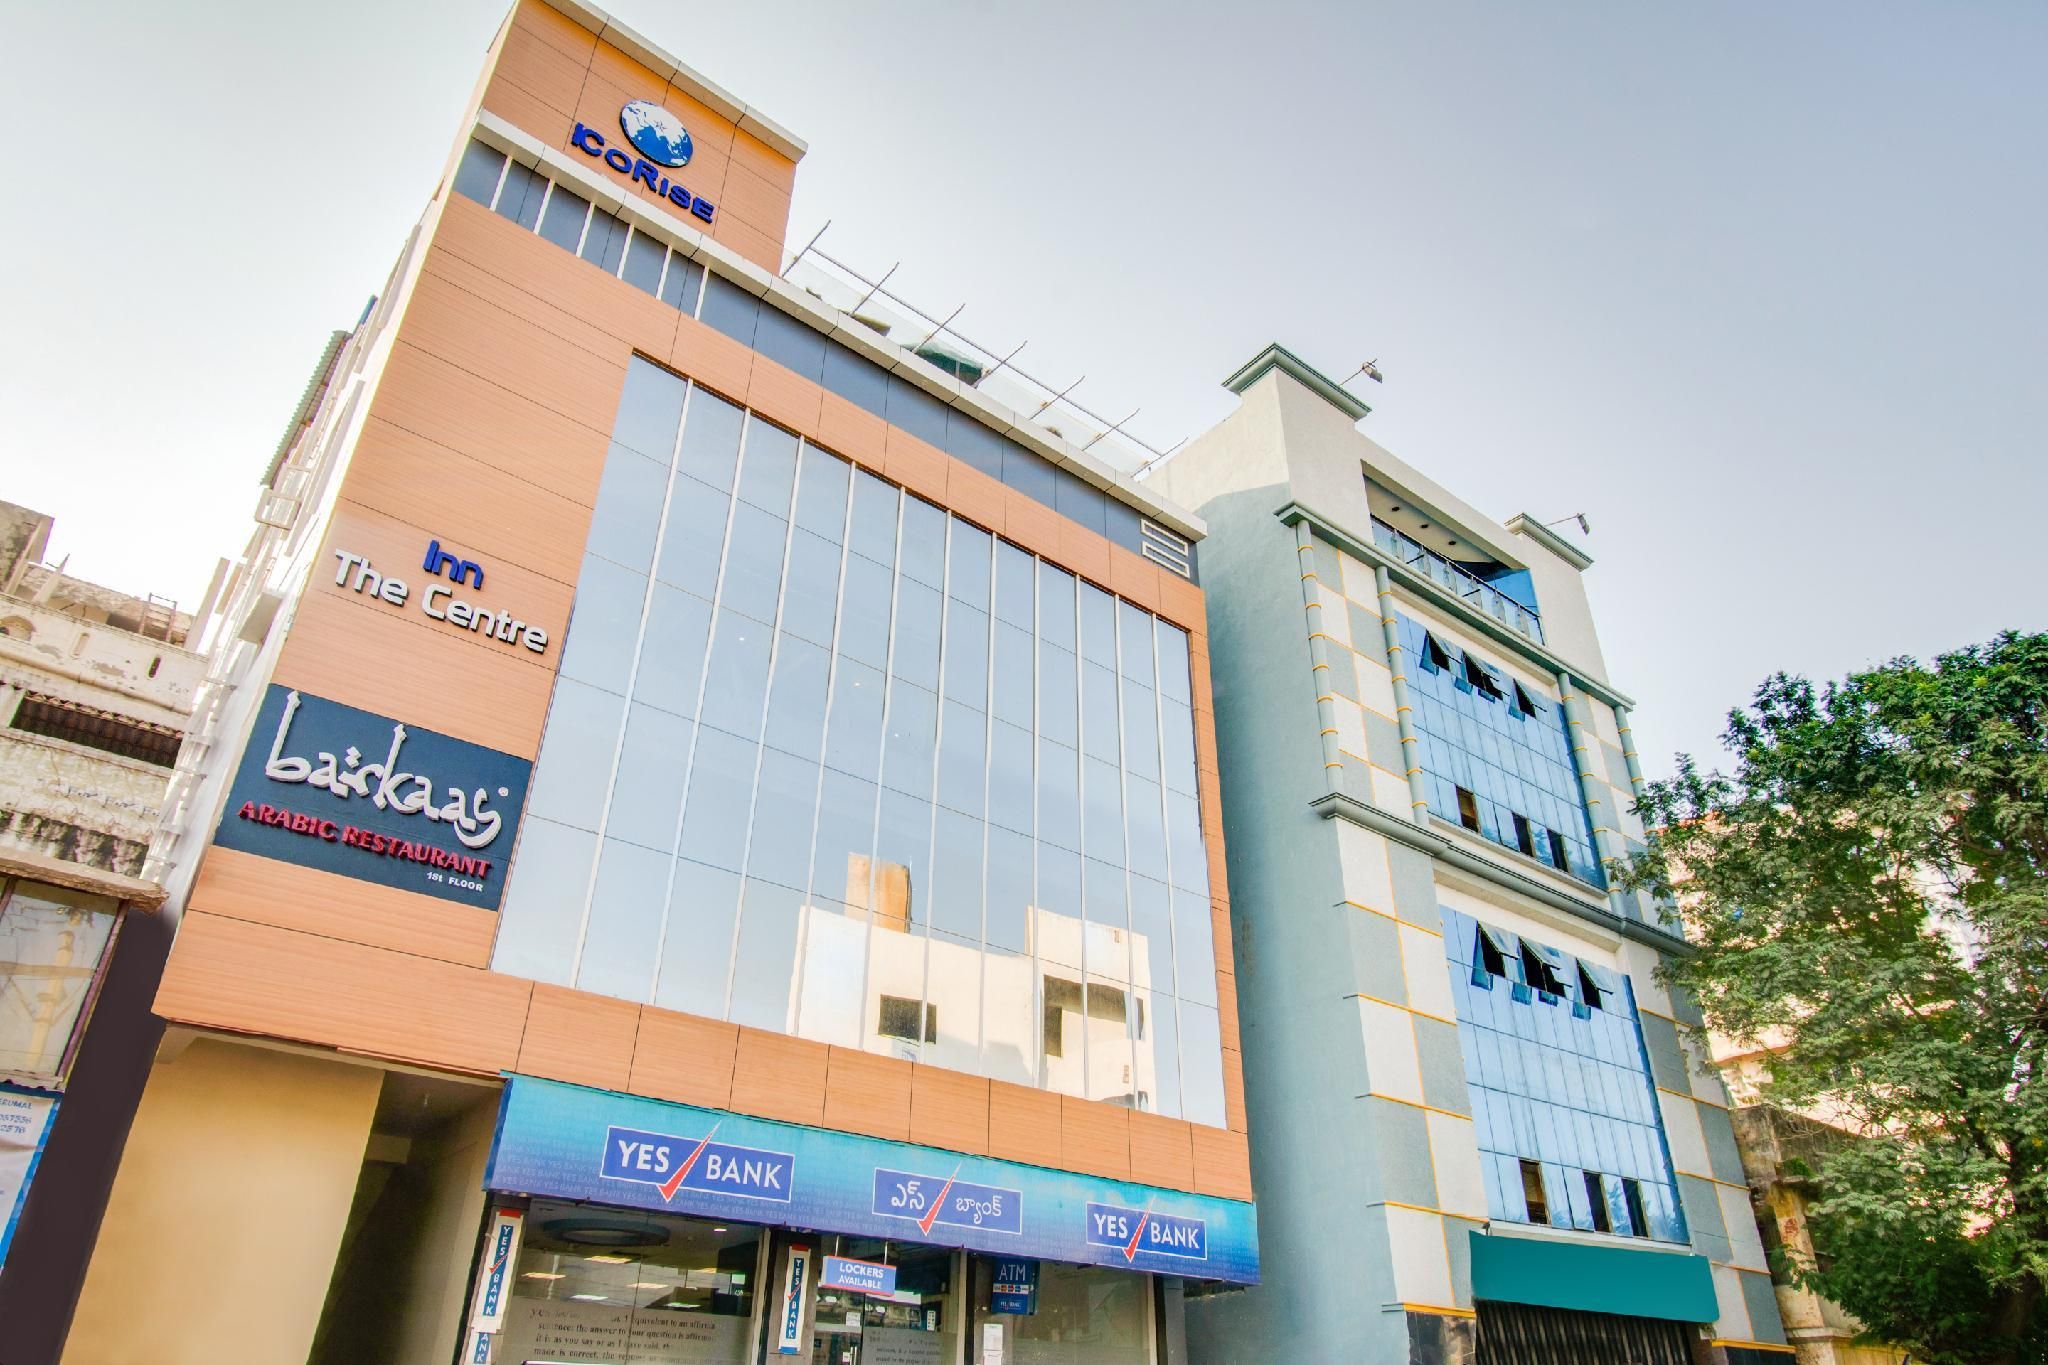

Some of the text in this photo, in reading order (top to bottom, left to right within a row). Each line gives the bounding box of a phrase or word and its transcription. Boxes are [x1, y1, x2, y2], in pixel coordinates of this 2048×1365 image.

[422, 540, 484, 590] Inn
[335, 548, 548, 653] The Centre
[237, 800, 495, 879] ARABIC RESTAURANT
[449, 876, 483, 892] FLOOR
[617, 1139, 671, 1173] YES
[706, 1154, 781, 1189] BANK
[1093, 1212, 1199, 1249] YES BANK
[485, 1226, 512, 1316] YES BANK
[838, 1275, 882, 1290] AVAILABLE
[839, 1262, 884, 1278] LOCKERS
[999, 1264, 1026, 1281] ATM
[787, 1302, 797, 1338] BANK
[476, 1333, 489, 1363] ANK
